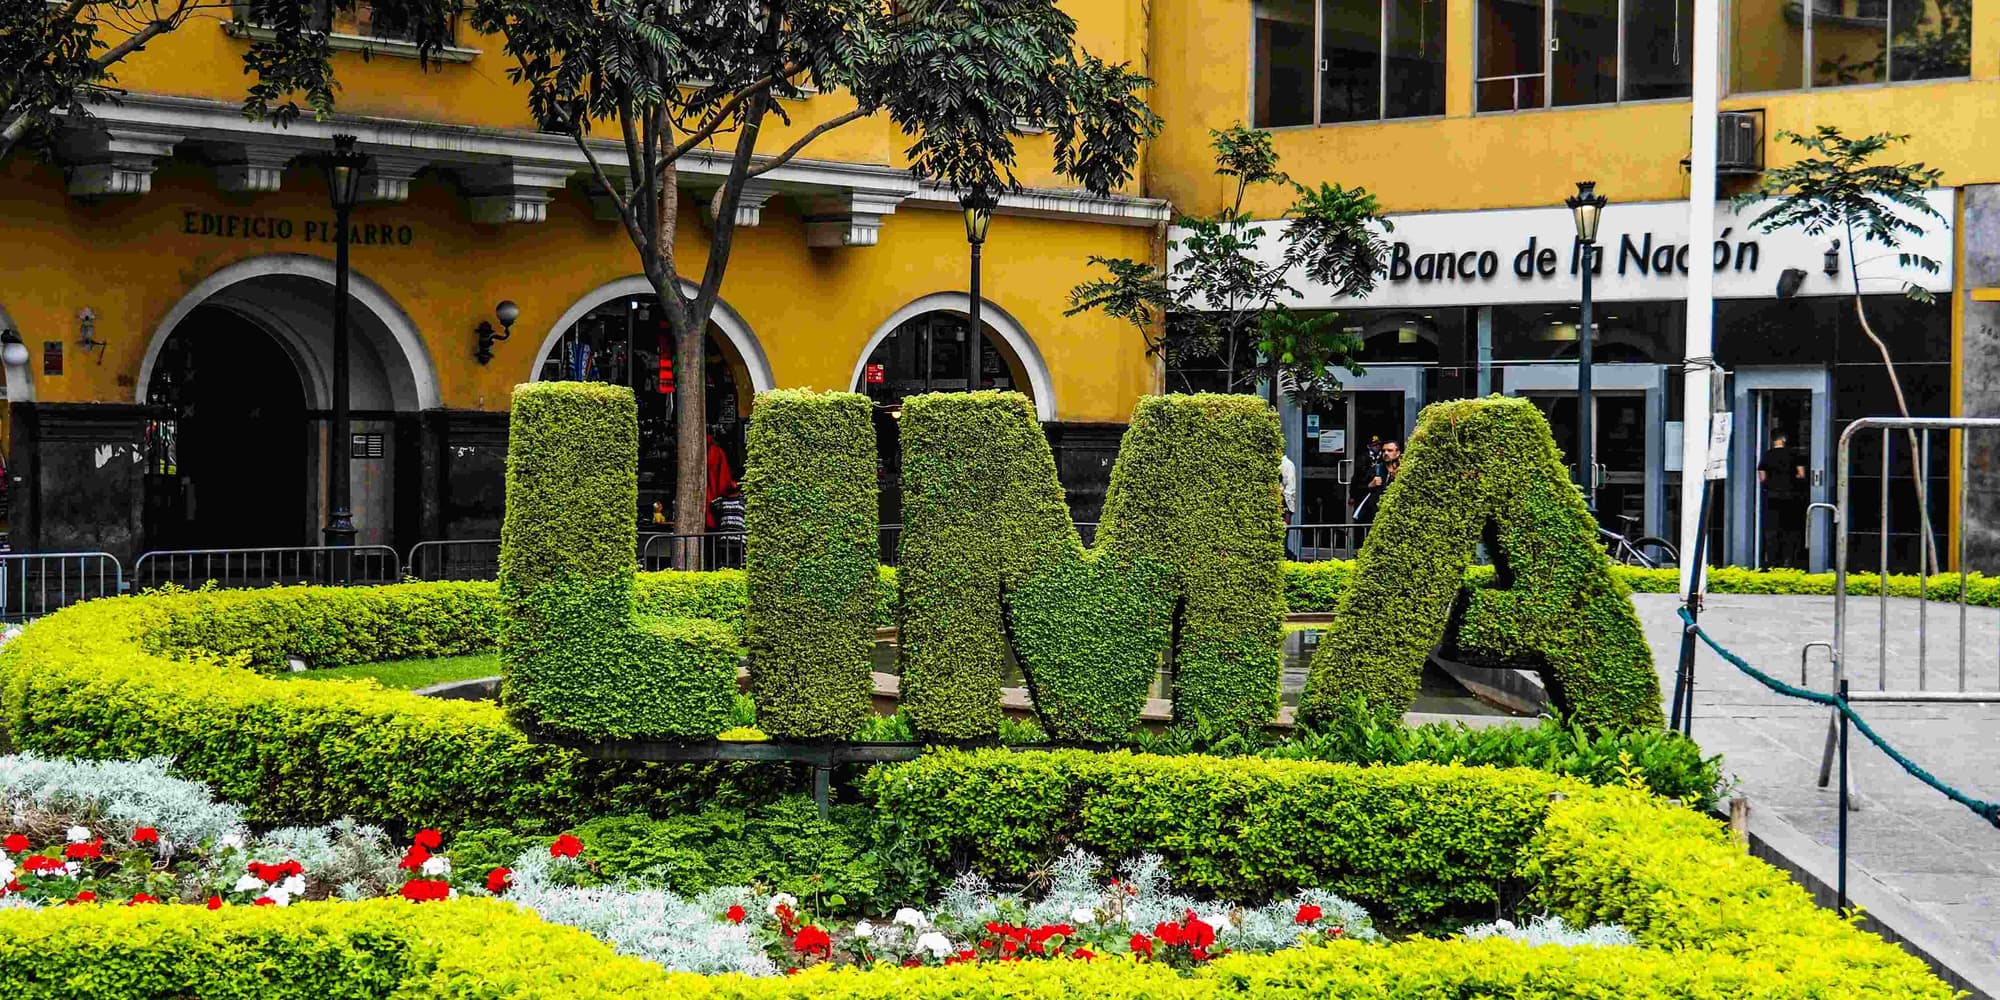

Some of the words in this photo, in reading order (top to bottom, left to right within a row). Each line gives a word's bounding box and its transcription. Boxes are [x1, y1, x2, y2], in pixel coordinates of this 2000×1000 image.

[184, 211, 293, 239] EDIFICIO
[1389, 242, 1498, 281] Banco
[1513, 236, 1557, 278] de
[1617, 227, 1760, 275] Nacón
[501, 381, 1662, 741] LIMA
